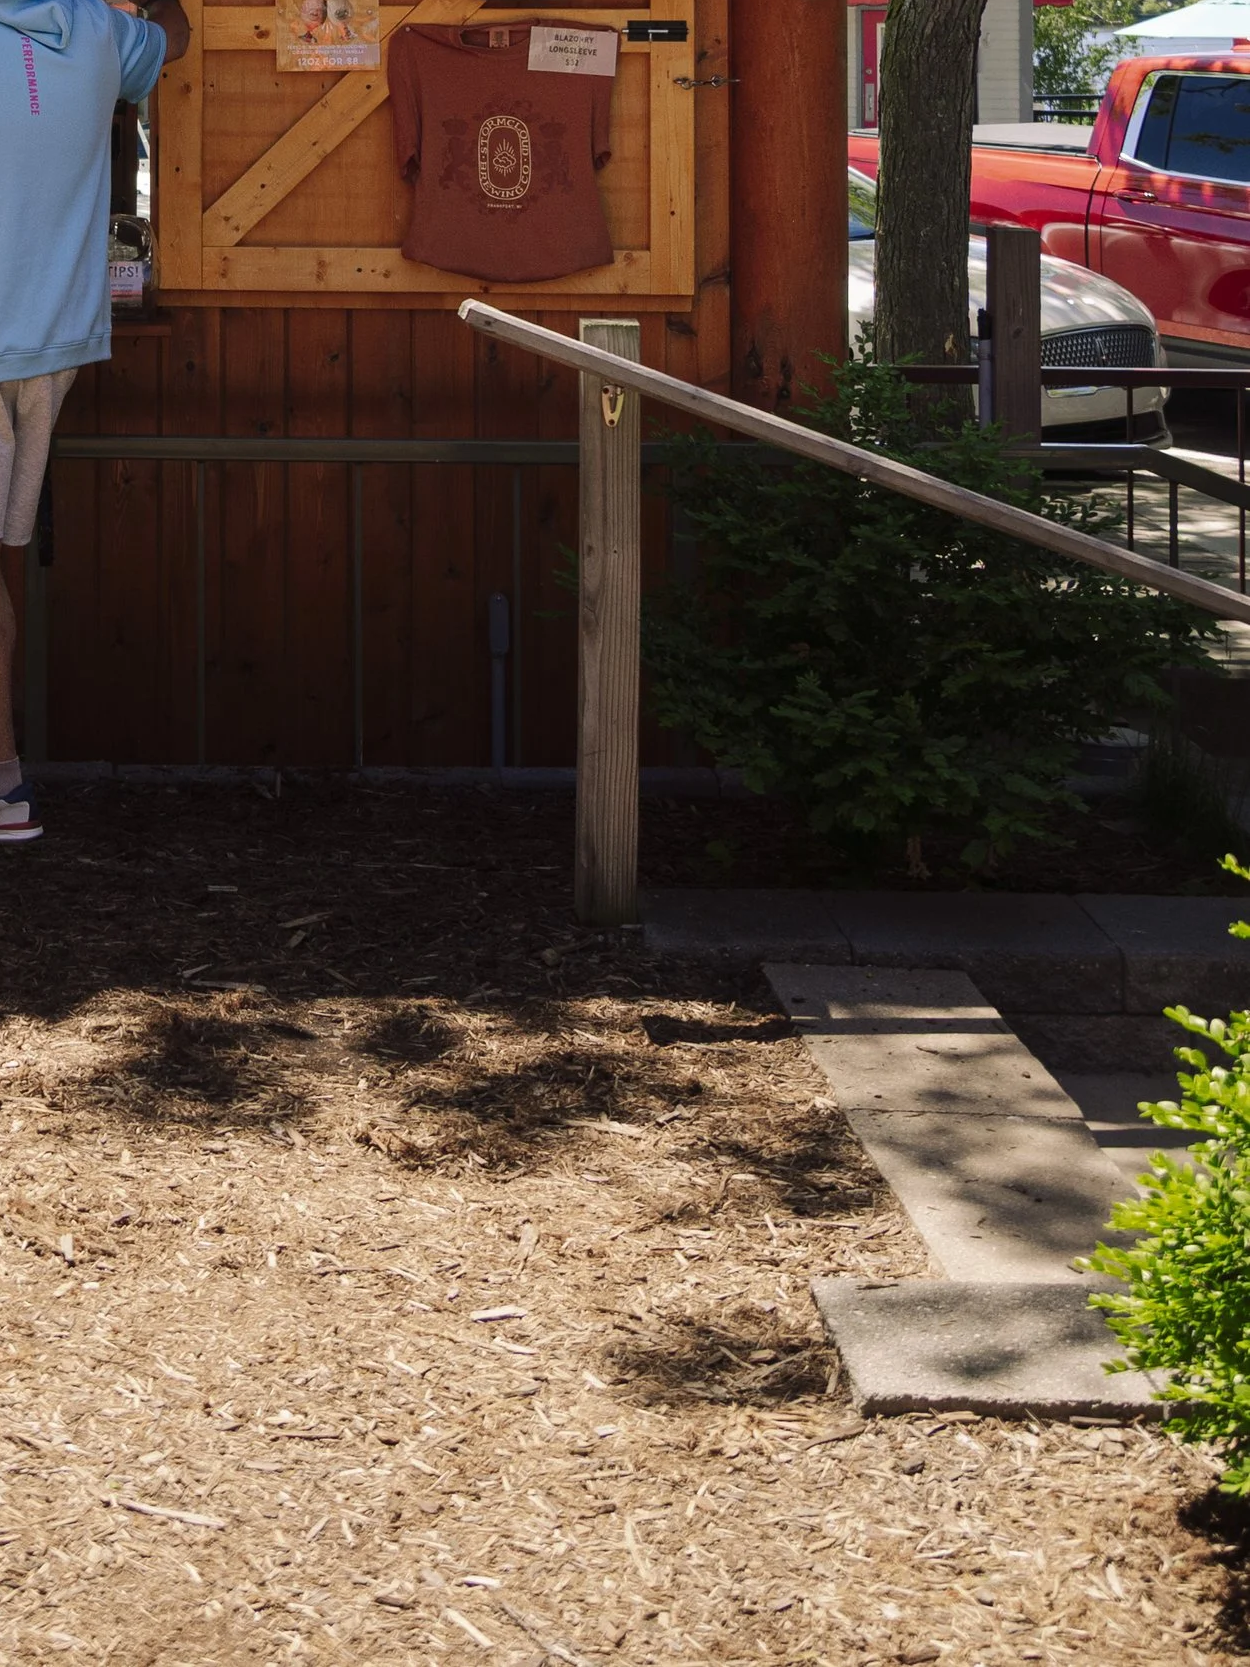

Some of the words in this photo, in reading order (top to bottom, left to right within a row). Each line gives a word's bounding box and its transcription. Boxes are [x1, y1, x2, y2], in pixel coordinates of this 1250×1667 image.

[323, 57, 343, 66] FOR
[549, 46, 597, 56] LONGSLEEVE
[20, 36, 40, 116] PERFORMANCE
[480, 117, 529, 157] STORMCLOUD
[480, 161, 524, 198] BREWING
[108, 265, 139, 278] TIPS!
